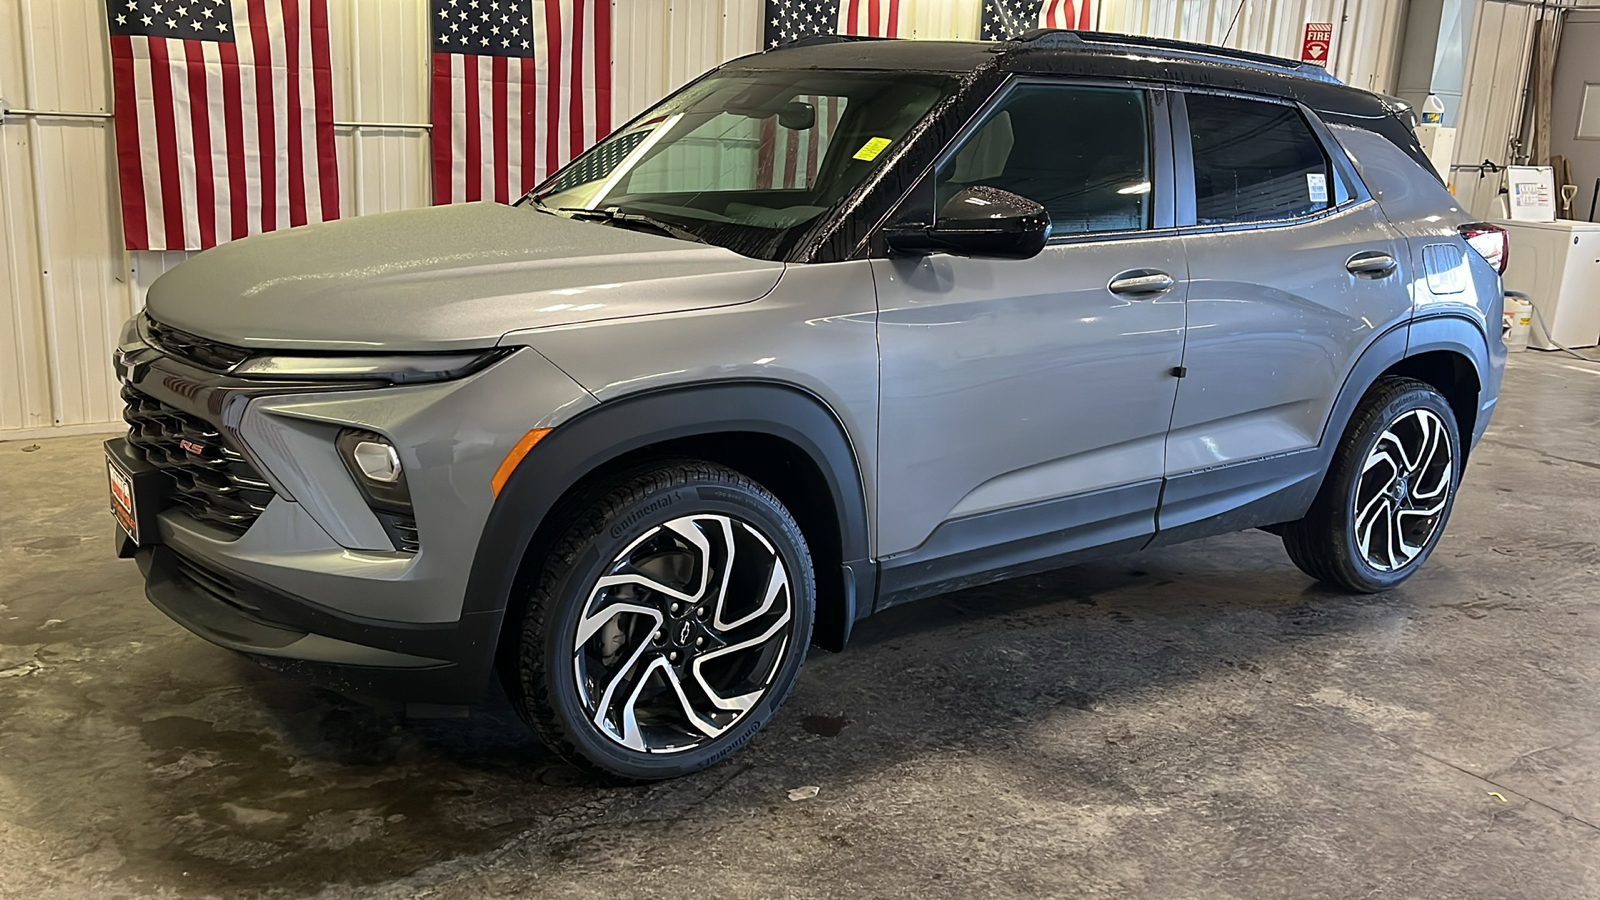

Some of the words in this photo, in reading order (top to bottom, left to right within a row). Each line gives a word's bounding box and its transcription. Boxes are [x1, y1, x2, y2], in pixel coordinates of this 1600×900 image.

[1307, 31, 1331, 41] FIRE
[180, 439, 204, 454] RS
[610, 494, 673, 539] Continental
